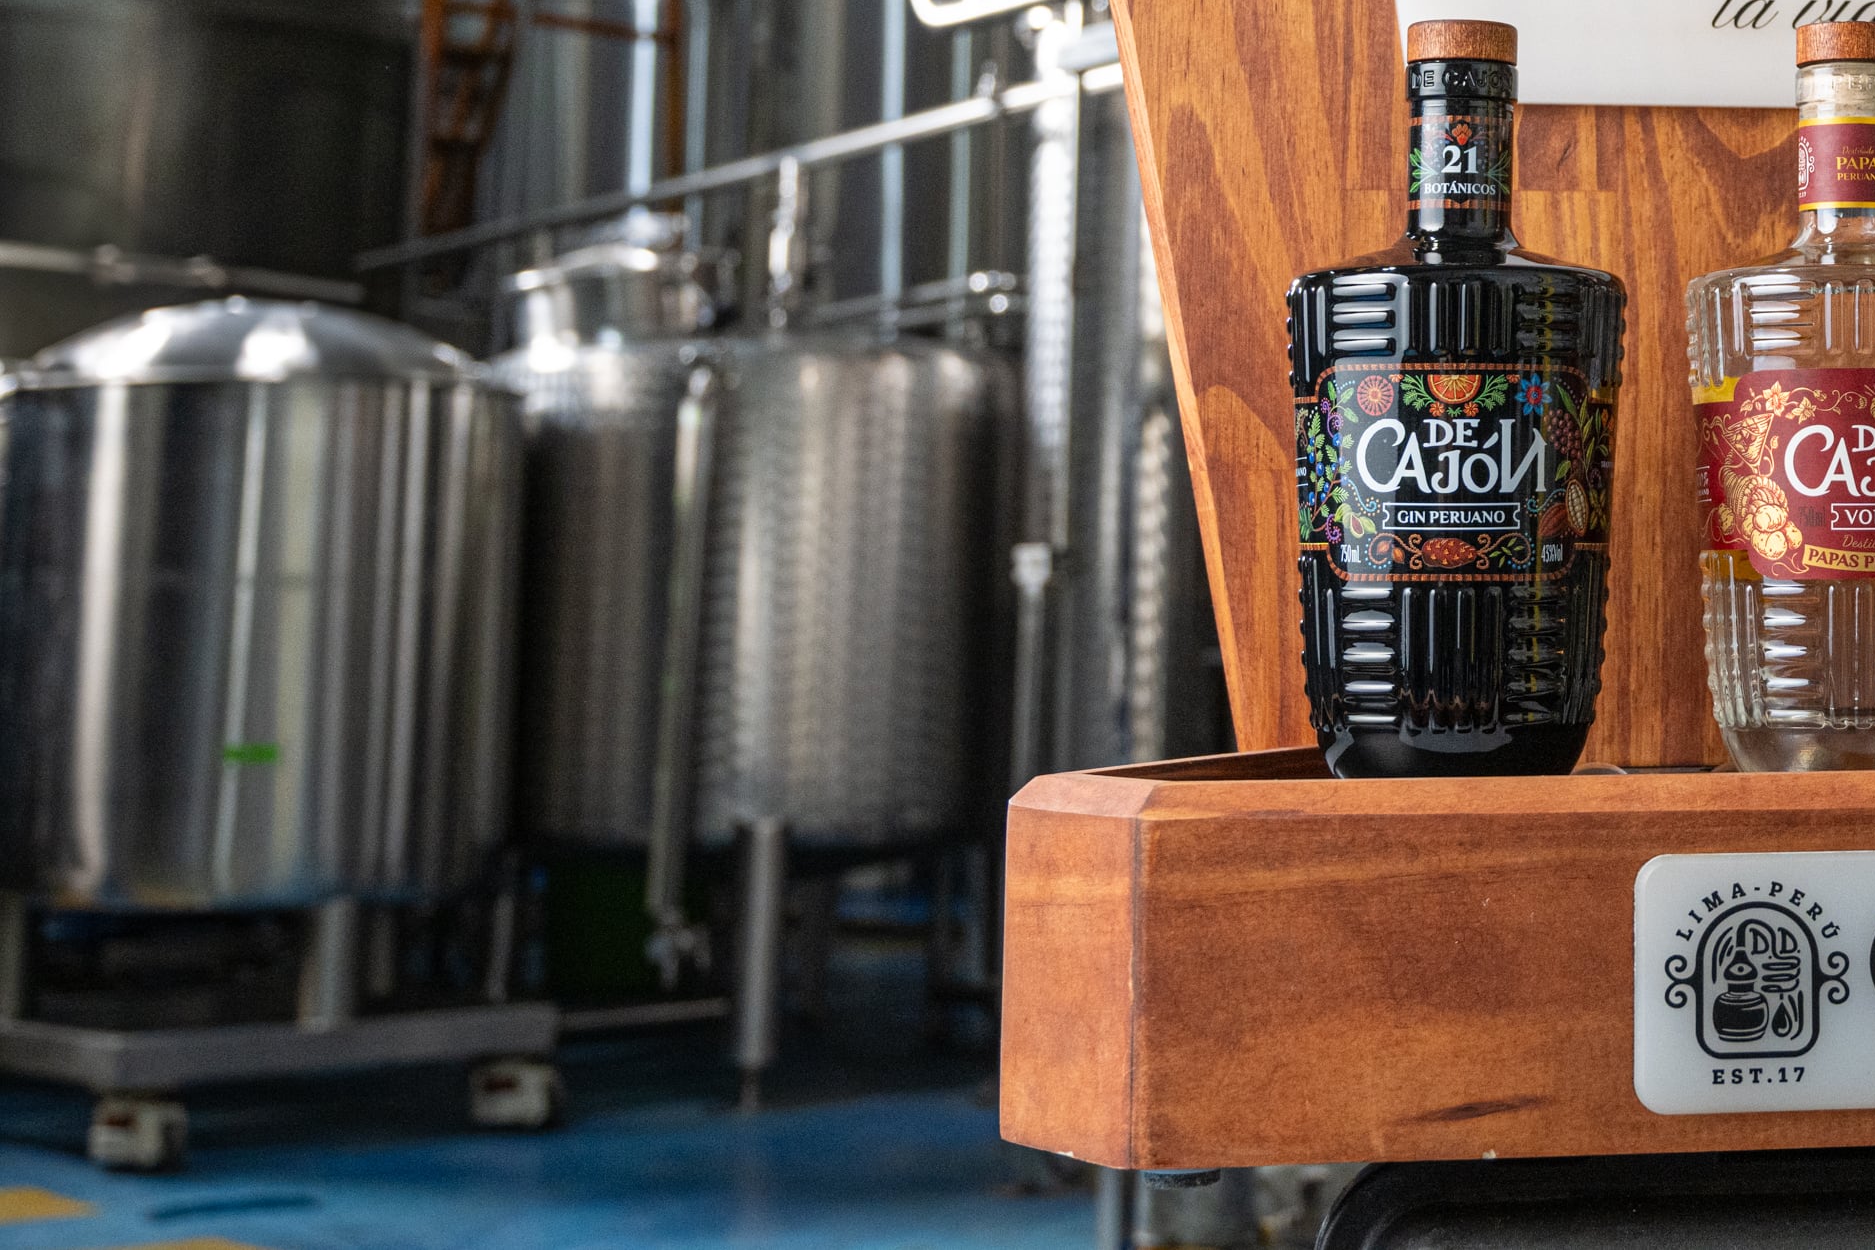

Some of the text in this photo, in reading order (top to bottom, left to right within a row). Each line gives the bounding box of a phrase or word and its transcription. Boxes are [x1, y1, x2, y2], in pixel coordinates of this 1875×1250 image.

[1441, 145, 1479, 174] 21
[1423, 180, 1496, 196] BOTÁNICOS
[1423, 419, 1480, 447] DE
[1356, 418, 1547, 494] CAJÓN
[1397, 510, 1505, 524] GIN PERUANO
[1808, 548, 1859, 568] PAPAS
[1712, 1066, 1806, 1085] EST.17
